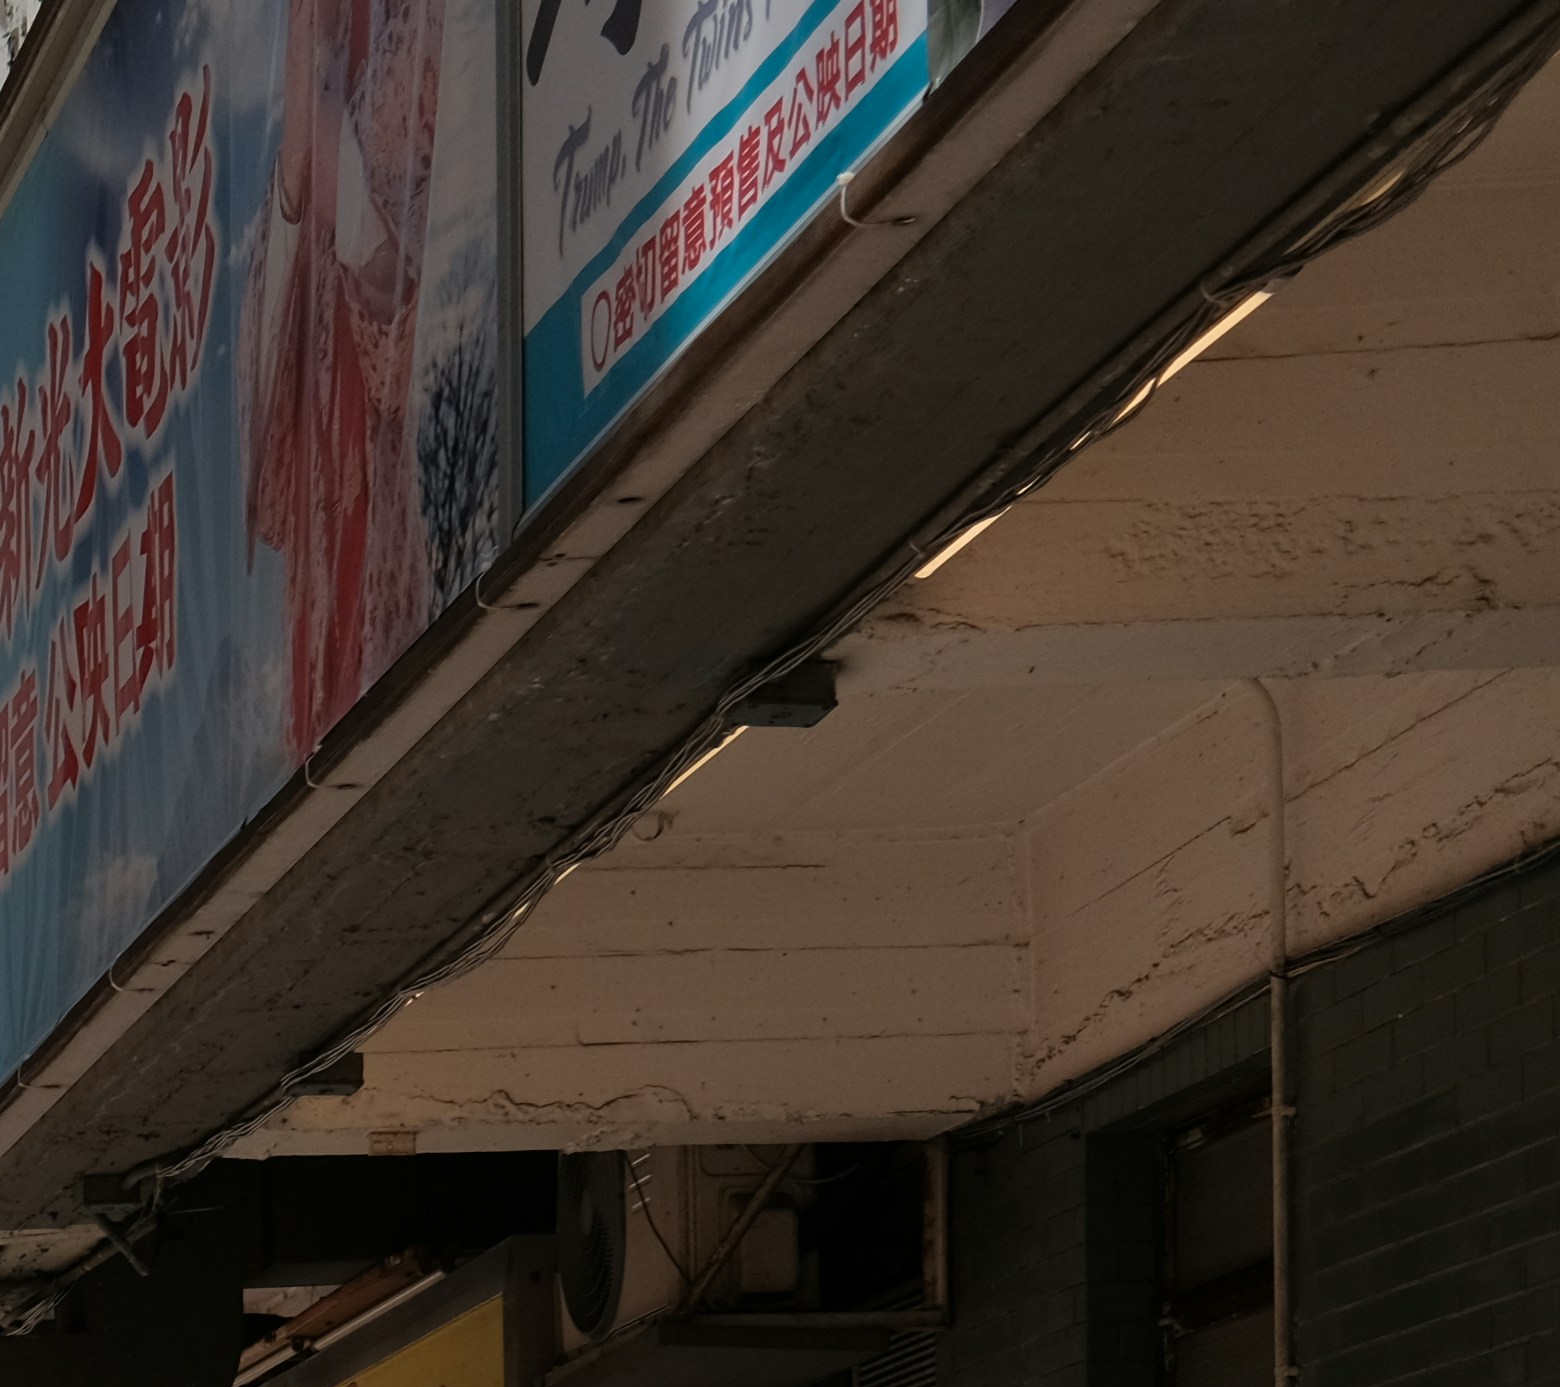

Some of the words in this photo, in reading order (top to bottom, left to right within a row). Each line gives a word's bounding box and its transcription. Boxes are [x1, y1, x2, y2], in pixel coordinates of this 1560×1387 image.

[552, 104, 627, 259] Trump,
[631, 42, 678, 173] The
[43, 471, 176, 814] 公映日期
